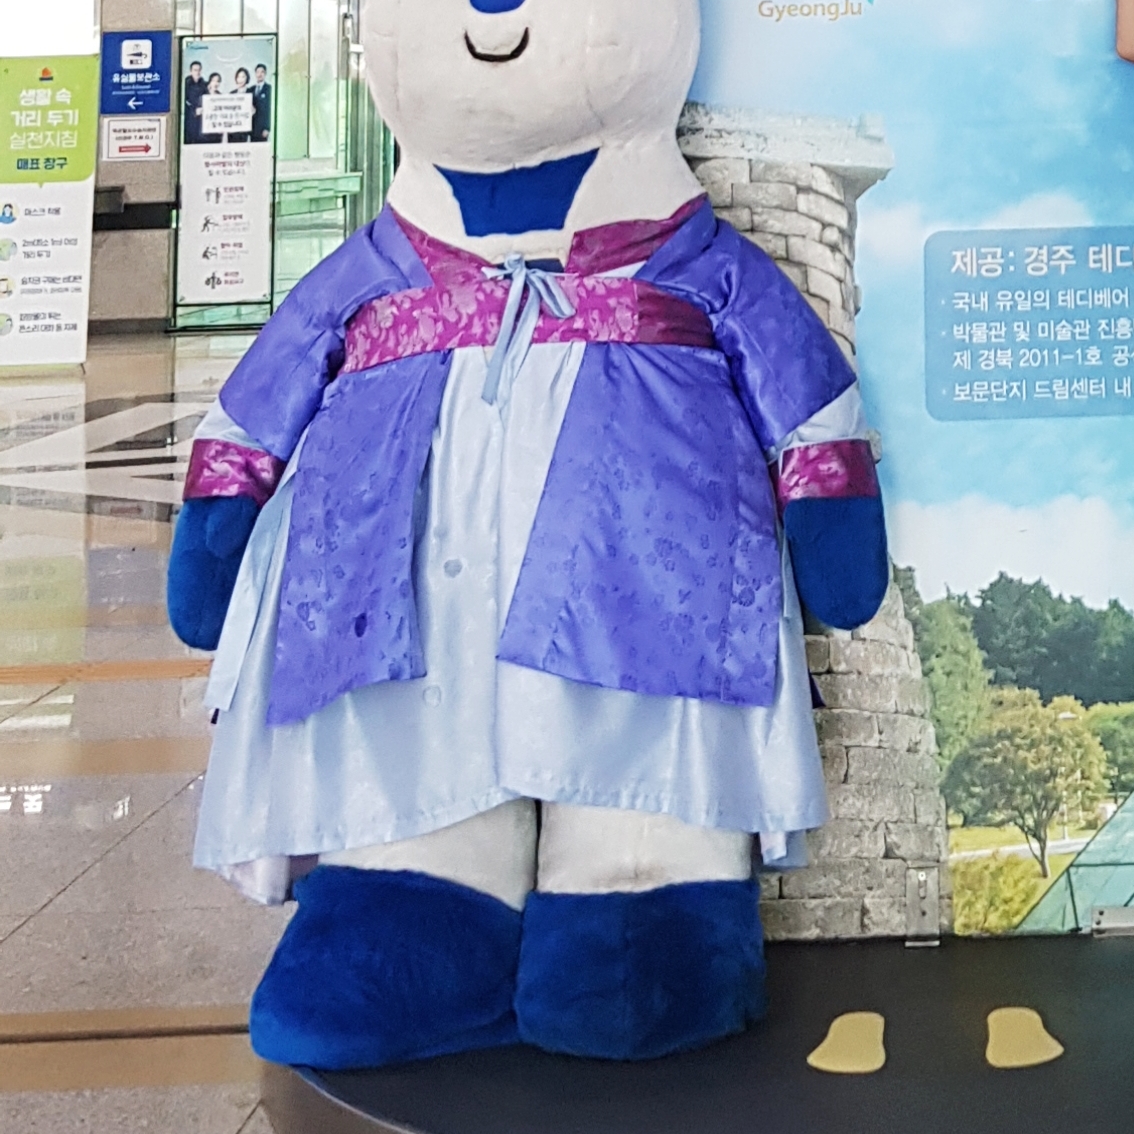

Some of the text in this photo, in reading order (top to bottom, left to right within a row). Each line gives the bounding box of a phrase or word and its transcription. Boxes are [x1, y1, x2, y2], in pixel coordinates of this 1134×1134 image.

[20, 87, 72, 106] 생활 속
[11, 108, 79, 127] 거리 두기
[10, 130, 78, 150] 실천지침
[16, 156, 67, 170] 매표 창구
[951, 248, 1016, 277] 제공:
[1024, 245, 1077, 275] 경주
[952, 290, 988, 313] 국내
[996, 289, 1050, 312] 유일의
[1058, 287, 1130, 310] 테디베어
[953, 321, 1007, 343] 박물관
[1013, 320, 1031, 342] 및
[1037, 319, 1090, 341] 미술관
[953, 348, 972, 370] 제
[978, 347, 1013, 369] 경북
[1018, 346, 1103, 368] 2011-1호
[953, 379, 1027, 403] 보문단지
[1033, 377, 1107, 401] 드림센터
[1114, 375, 1132, 398] 내
